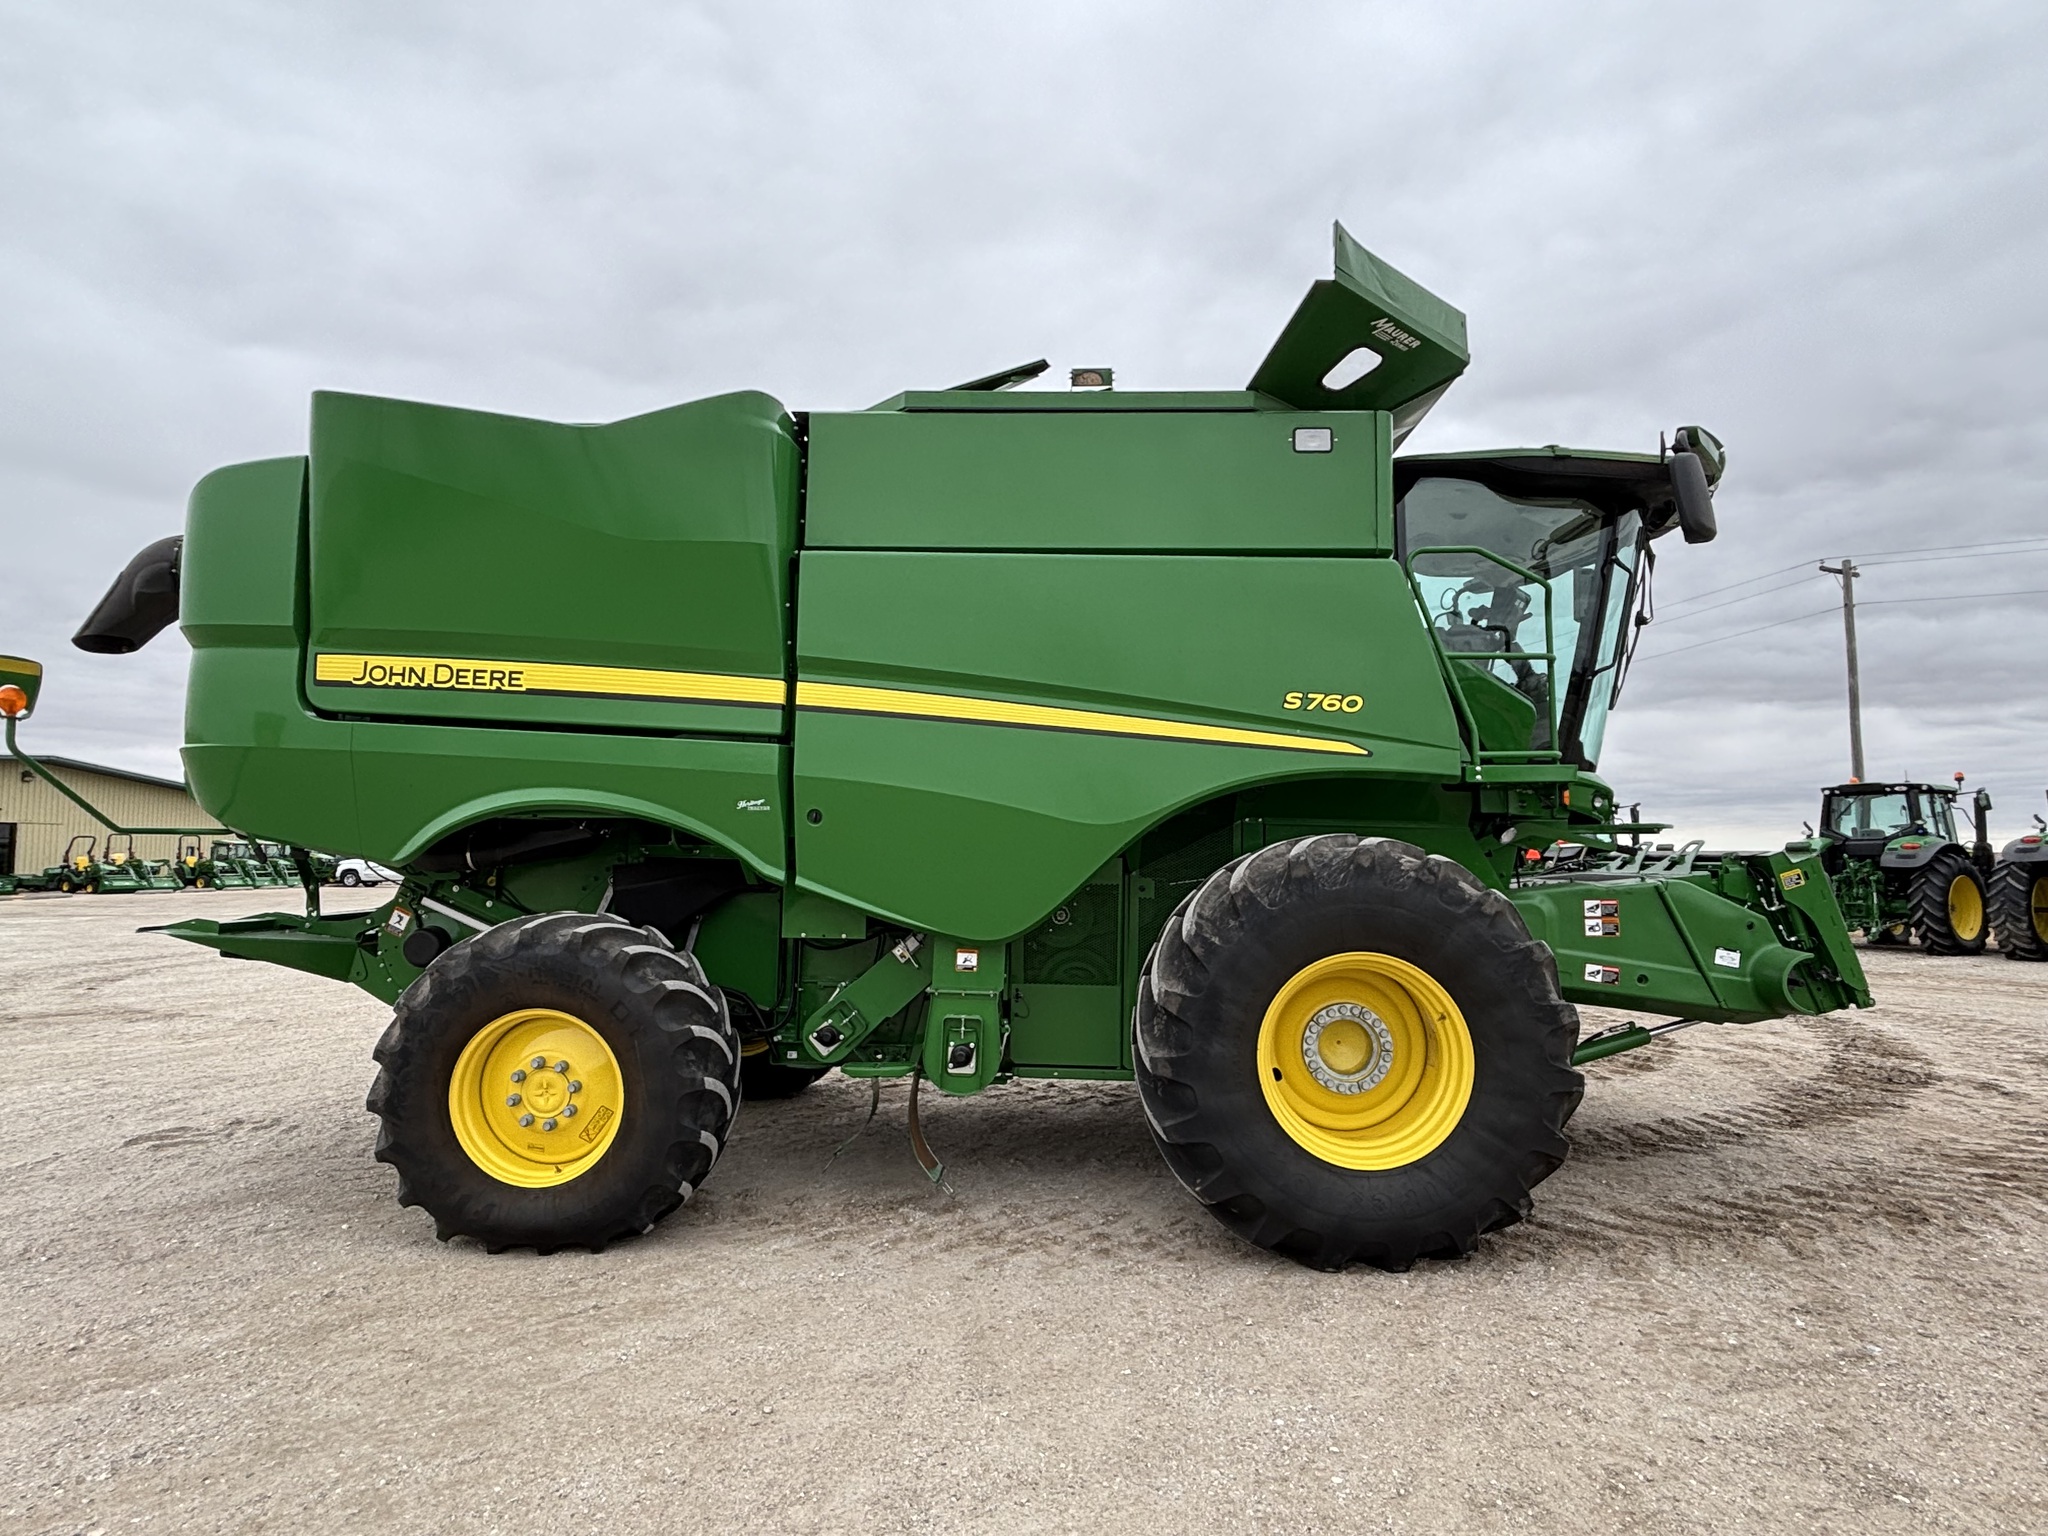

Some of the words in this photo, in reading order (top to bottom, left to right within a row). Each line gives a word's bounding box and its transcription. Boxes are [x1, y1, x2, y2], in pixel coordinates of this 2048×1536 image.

[1370, 317, 1421, 349] MAURER
[352, 660, 426, 684] JOHN
[433, 663, 524, 688] DEERE
[1282, 691, 1364, 713] S760
